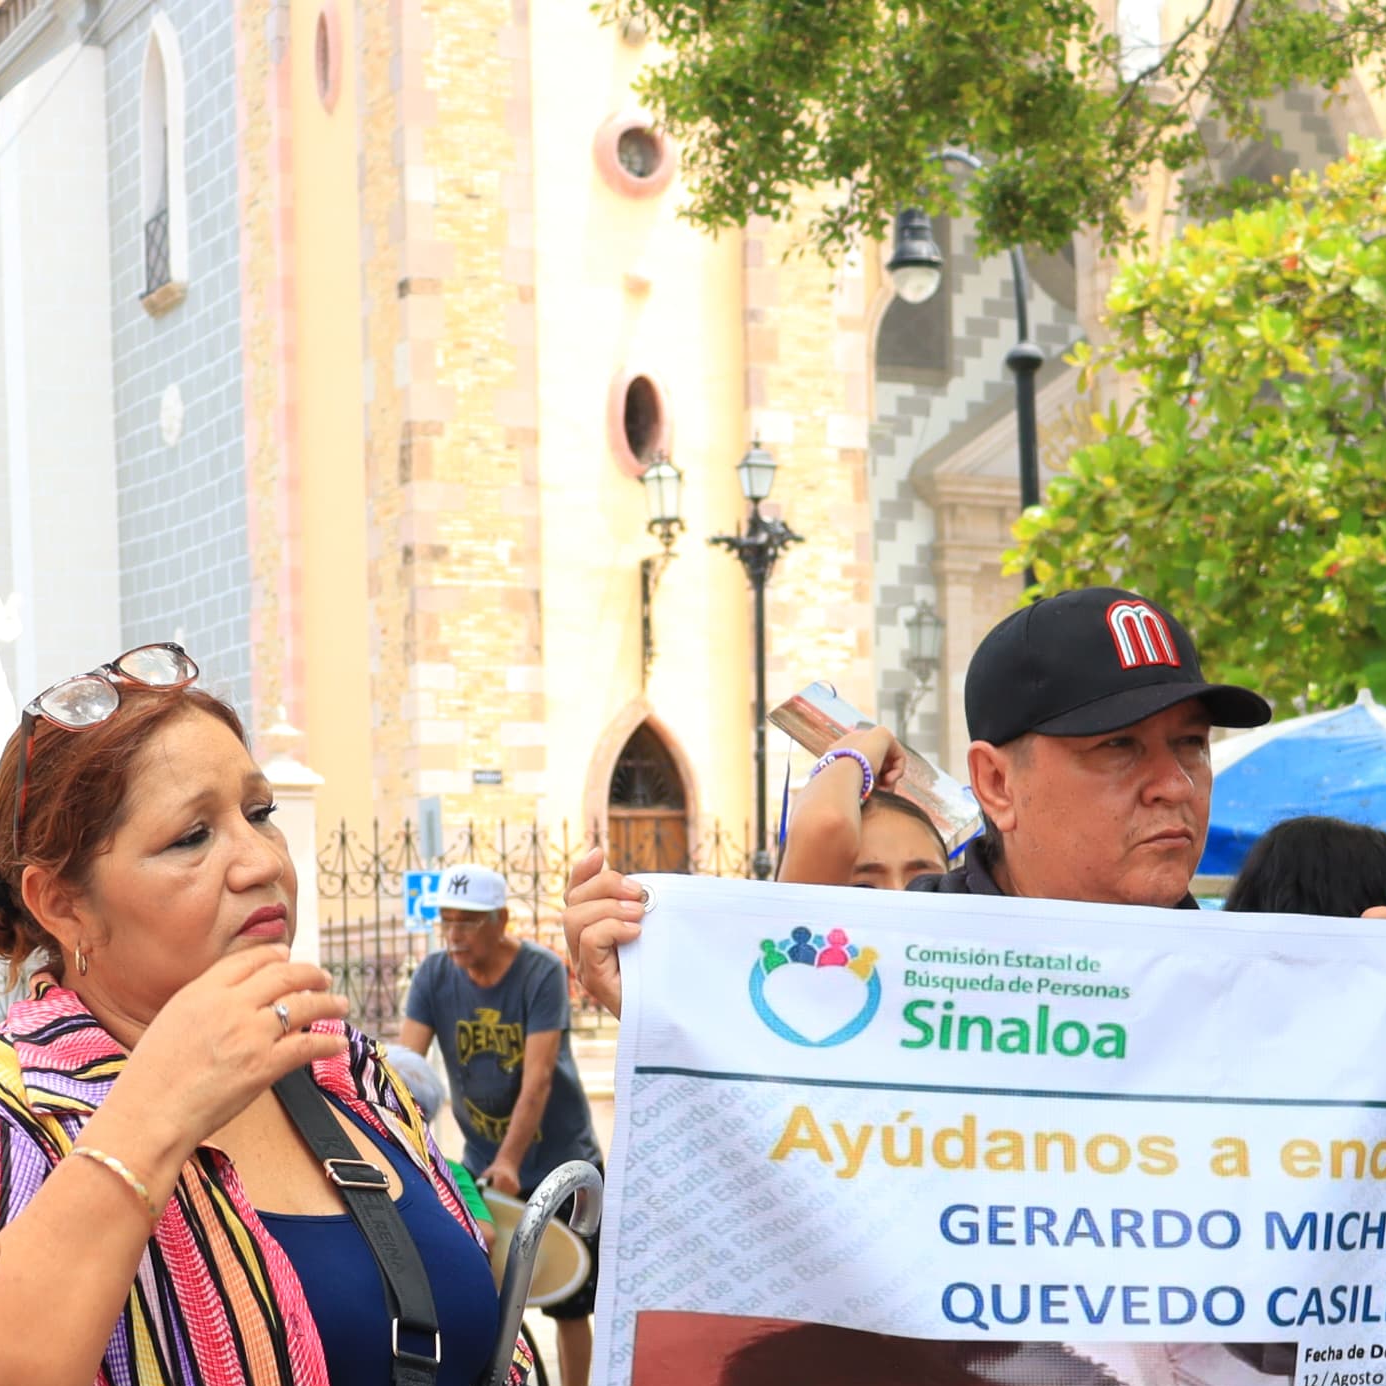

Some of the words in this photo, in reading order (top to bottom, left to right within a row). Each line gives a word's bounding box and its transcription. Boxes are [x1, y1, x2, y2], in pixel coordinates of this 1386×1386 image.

[905, 943, 1000, 970] Comisión
[1003, 950, 1071, 973] Estatal
[1074, 954, 1101, 974] de
[903, 969, 1004, 998] Búsqueda
[1007, 975, 1034, 995] de
[1037, 976, 1131, 1001] Personas
[899, 999, 1128, 1061] Sinaloa
[769, 1105, 1180, 1180] Ayúdanos
[1211, 1134, 1251, 1179] a
[938, 1203, 1243, 1253] GERARDO
[940, 1282, 1246, 1332] QUEVEDO
[1304, 1345, 1343, 1363] Fecha
[1347, 1344, 1365, 1359] de
